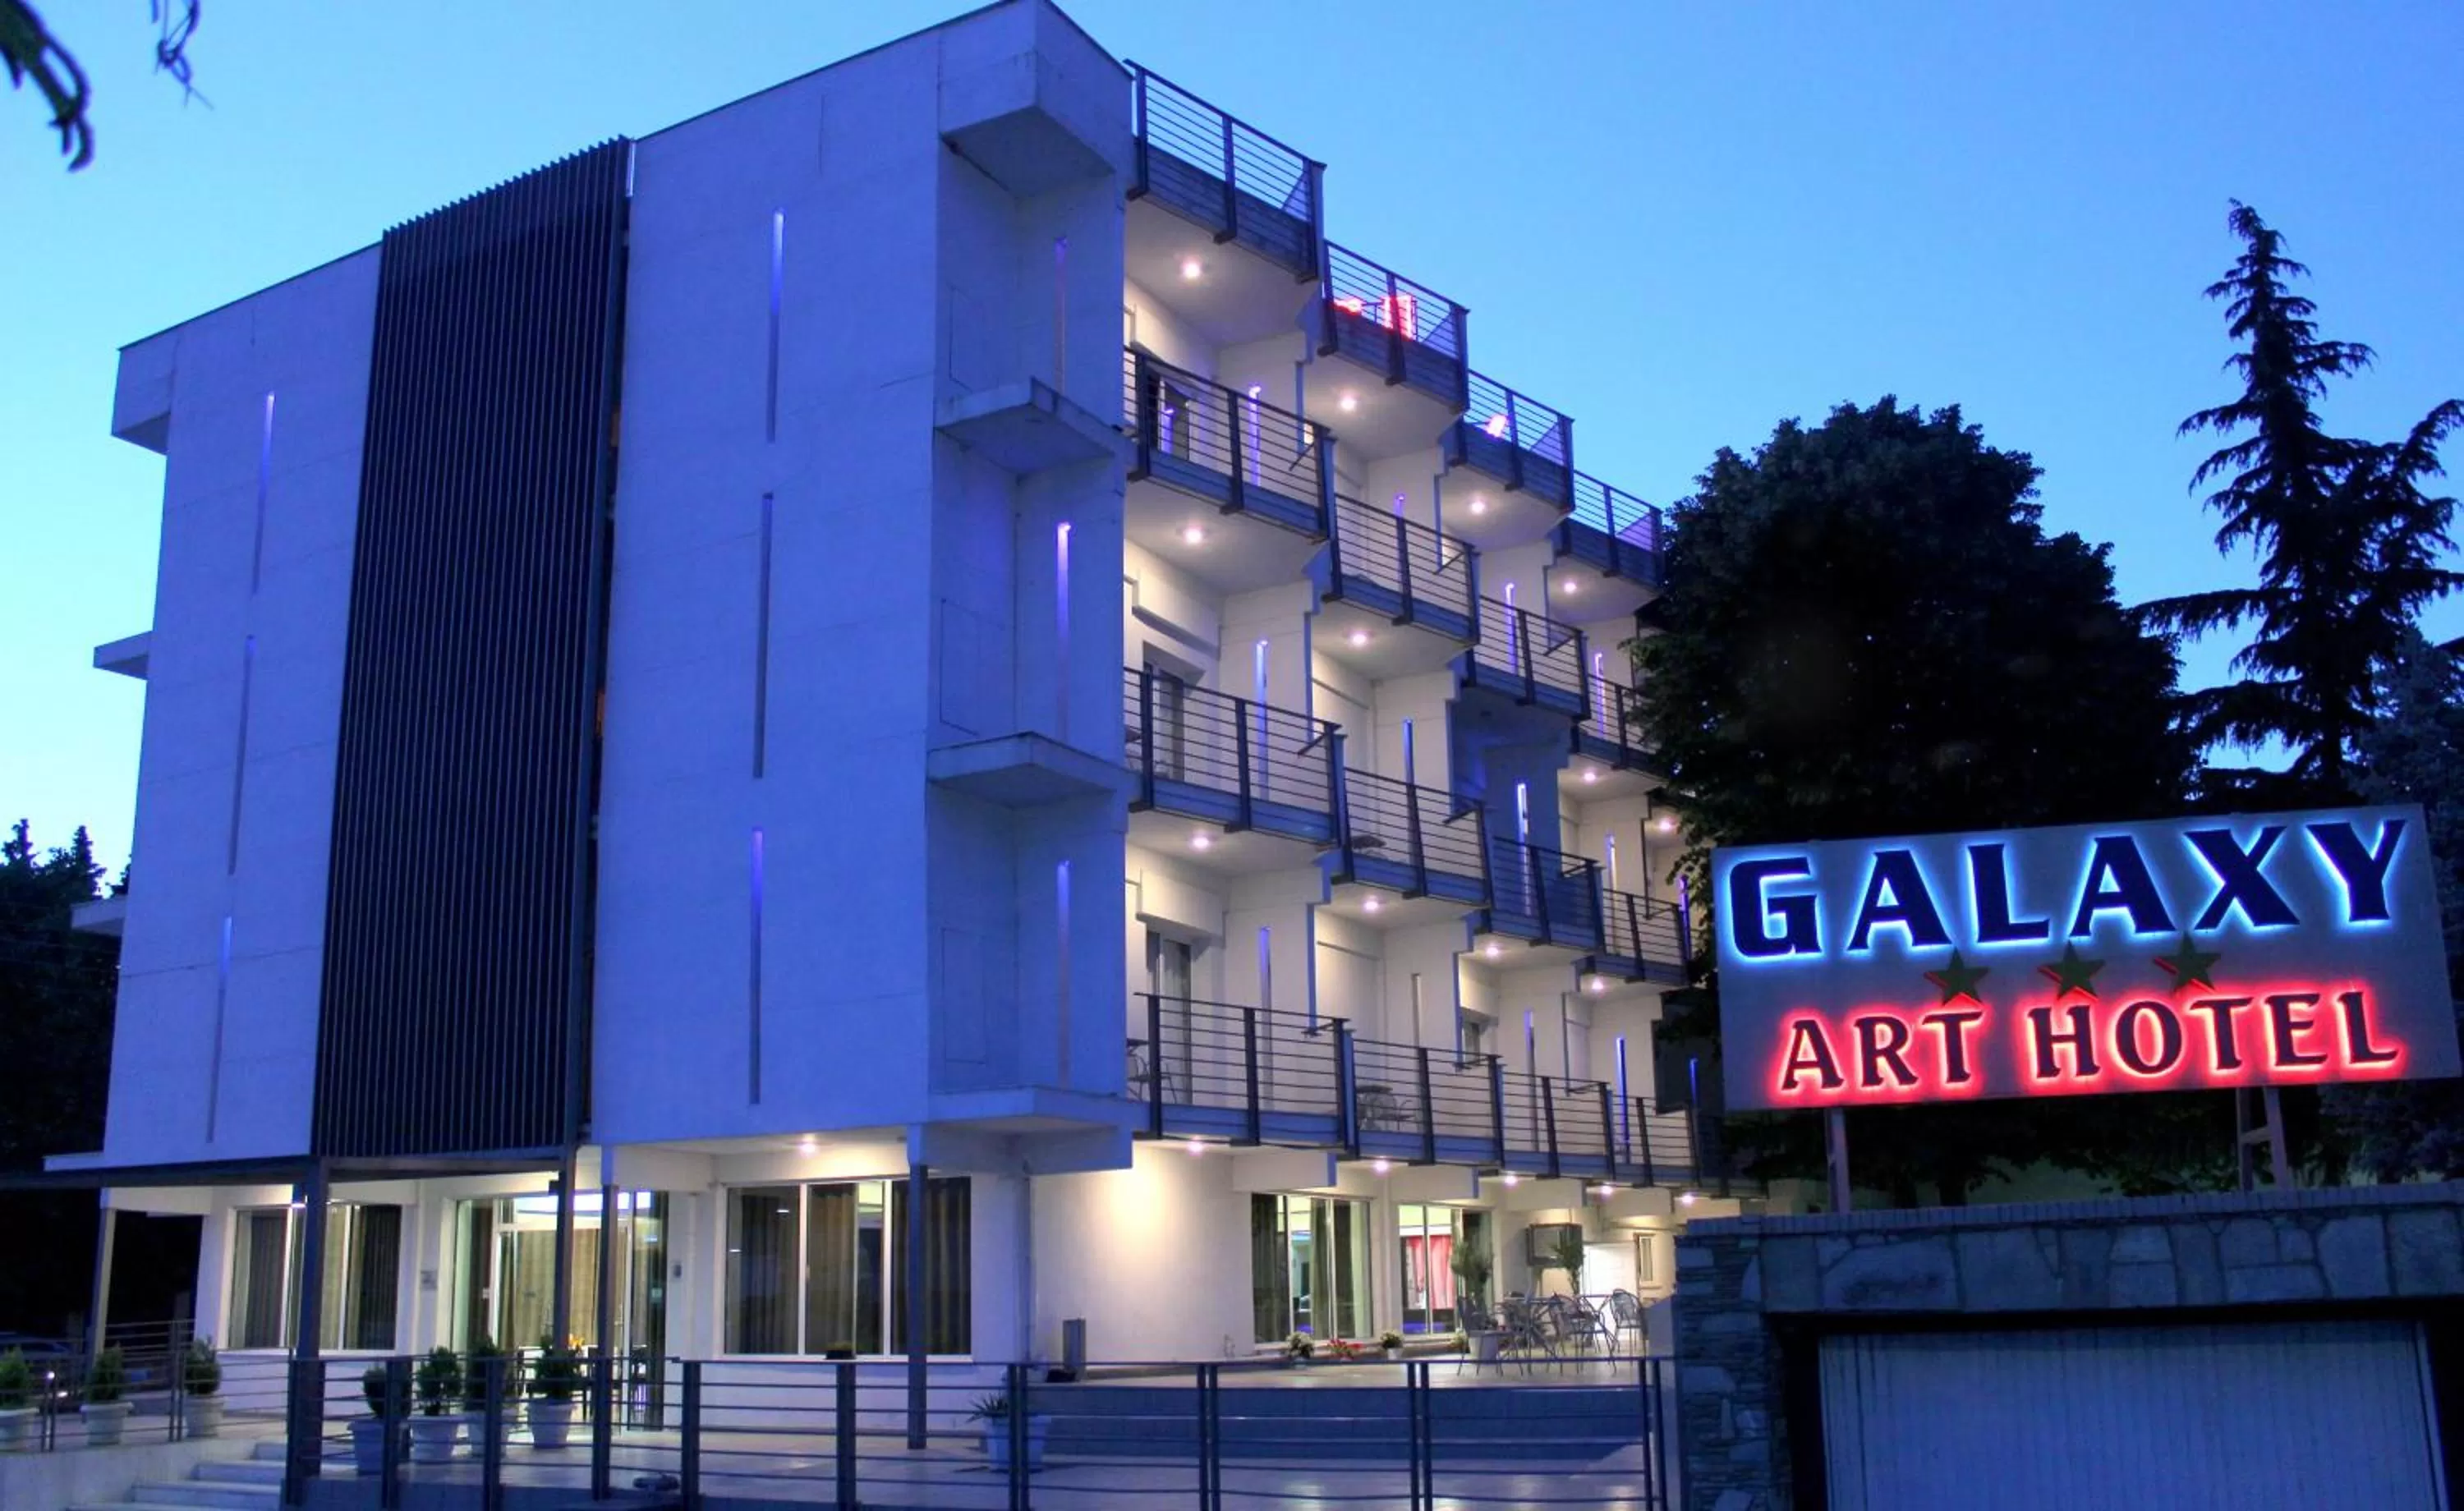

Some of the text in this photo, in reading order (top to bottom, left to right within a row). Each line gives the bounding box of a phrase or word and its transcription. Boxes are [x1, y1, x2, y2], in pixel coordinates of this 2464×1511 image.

[1729, 820, 2407, 958] GALAXY
[1781, 991, 2398, 1091] ART HOTEL
